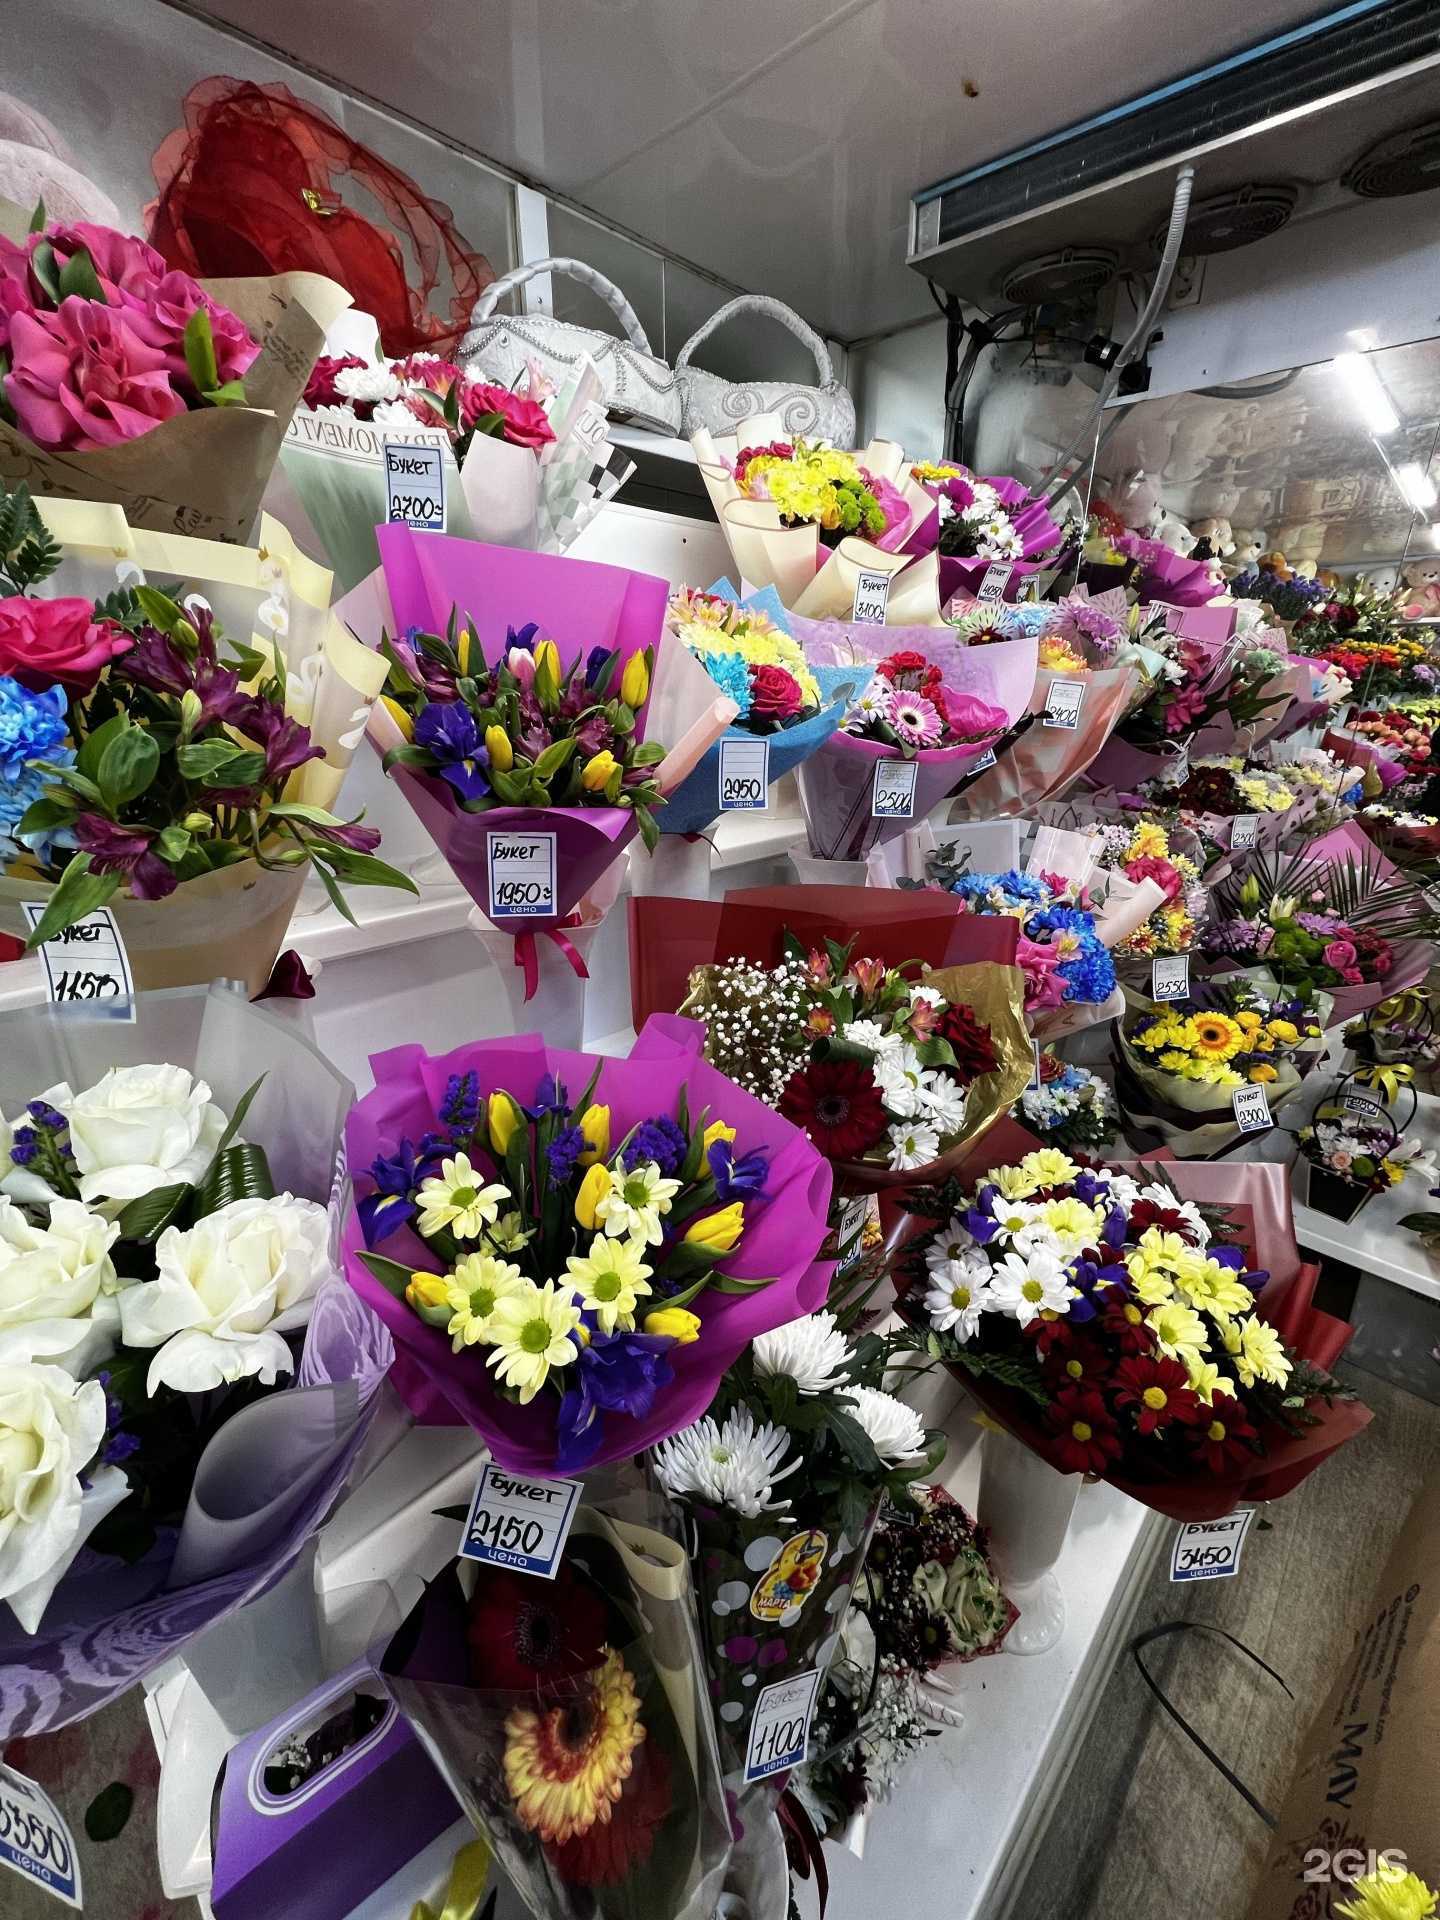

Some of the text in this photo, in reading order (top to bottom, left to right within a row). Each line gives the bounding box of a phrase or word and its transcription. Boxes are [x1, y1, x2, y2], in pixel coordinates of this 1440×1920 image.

[408, 520, 429, 528] ена
[724, 778, 761, 800] 2950
[1156, 980, 1187, 994] 2550
[1239, 1107, 1265, 1126] 2300
[469, 1510, 544, 1554] 2150
[488, 1549, 528, 1567] цена
[1179, 1546, 1232, 1570] 3450
[1190, 1568, 1218, 1577] цена
[757, 1598, 792, 1609] МАРТА
[763, 1756, 790, 1773] цена
[11, 1849, 52, 1884] цена
